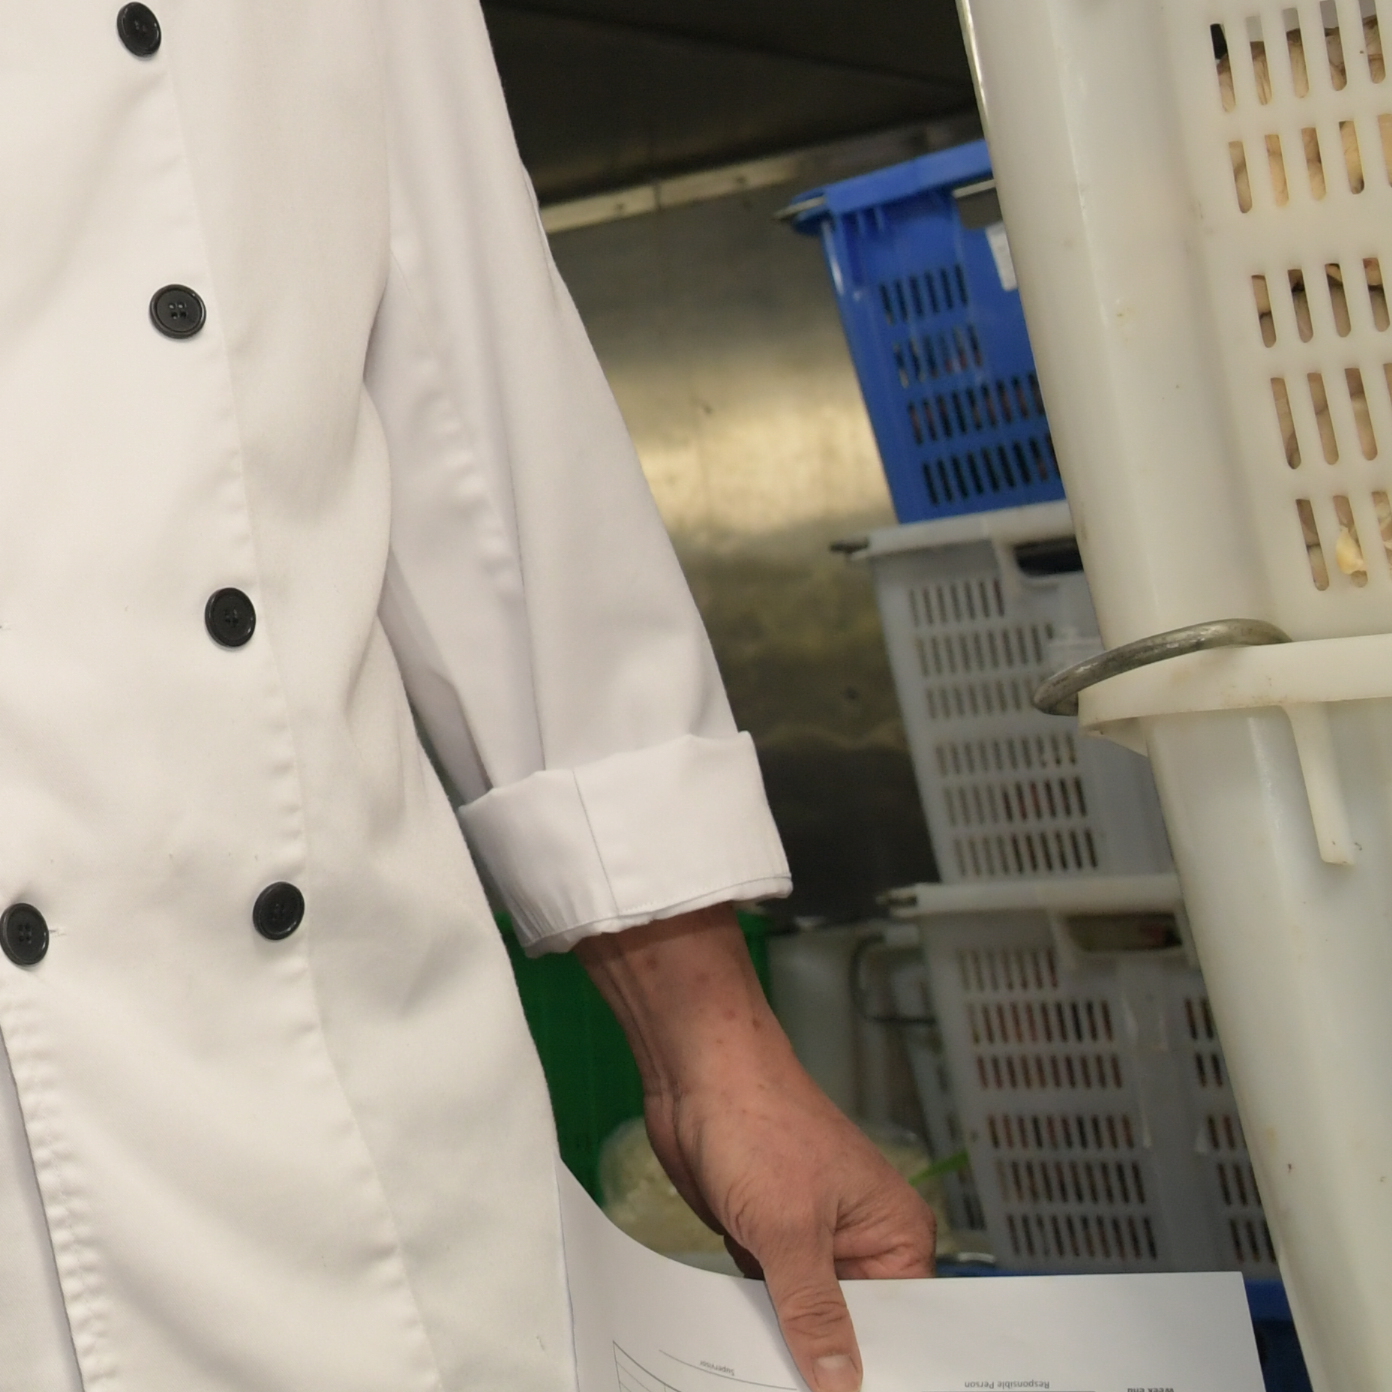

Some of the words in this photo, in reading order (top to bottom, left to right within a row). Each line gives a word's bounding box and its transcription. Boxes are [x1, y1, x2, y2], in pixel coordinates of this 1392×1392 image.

[700, 1360, 735, 1376] Supervisor
[964, 1381, 994, 1390] Person
[997, 1380, 1050, 1390] Responsible
